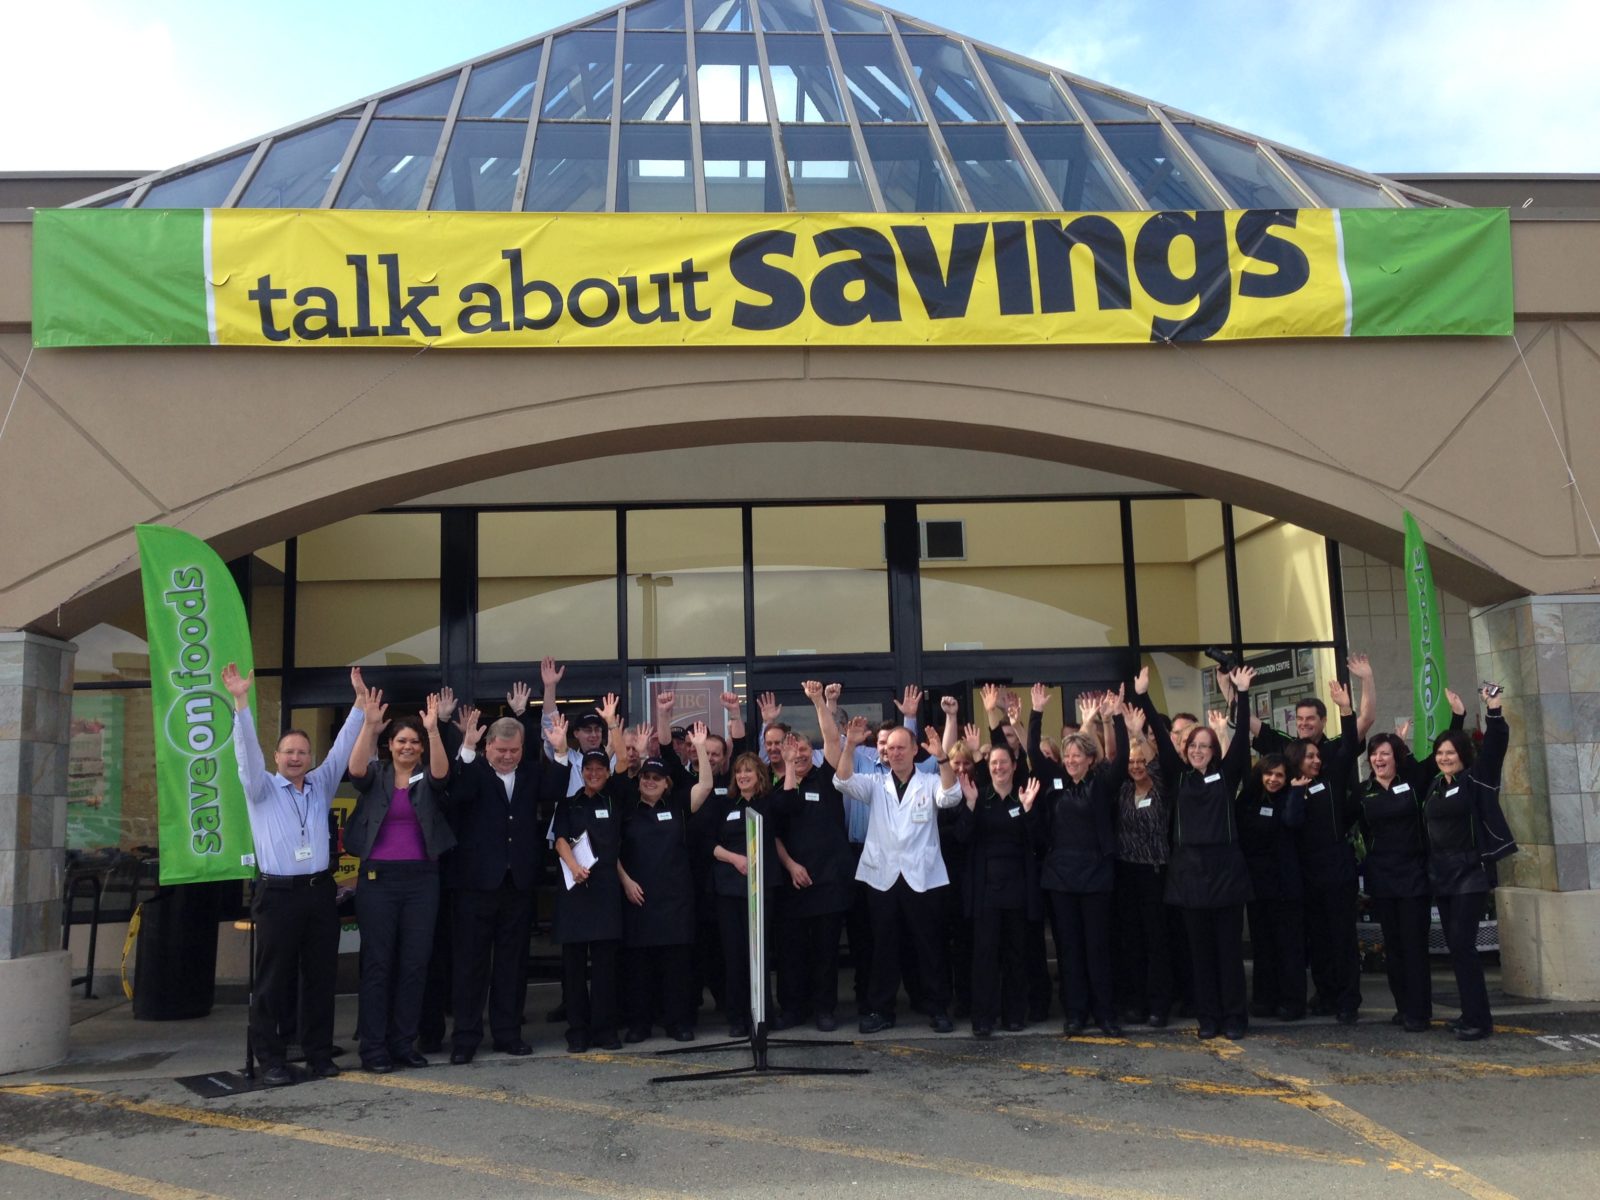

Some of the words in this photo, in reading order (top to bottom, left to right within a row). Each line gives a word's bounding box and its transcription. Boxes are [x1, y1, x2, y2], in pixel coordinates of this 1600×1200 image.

[248, 253, 441, 341] talk
[457, 248, 711, 332] about
[729, 209, 1310, 341] savings
[675, 693, 706, 708] IBC
